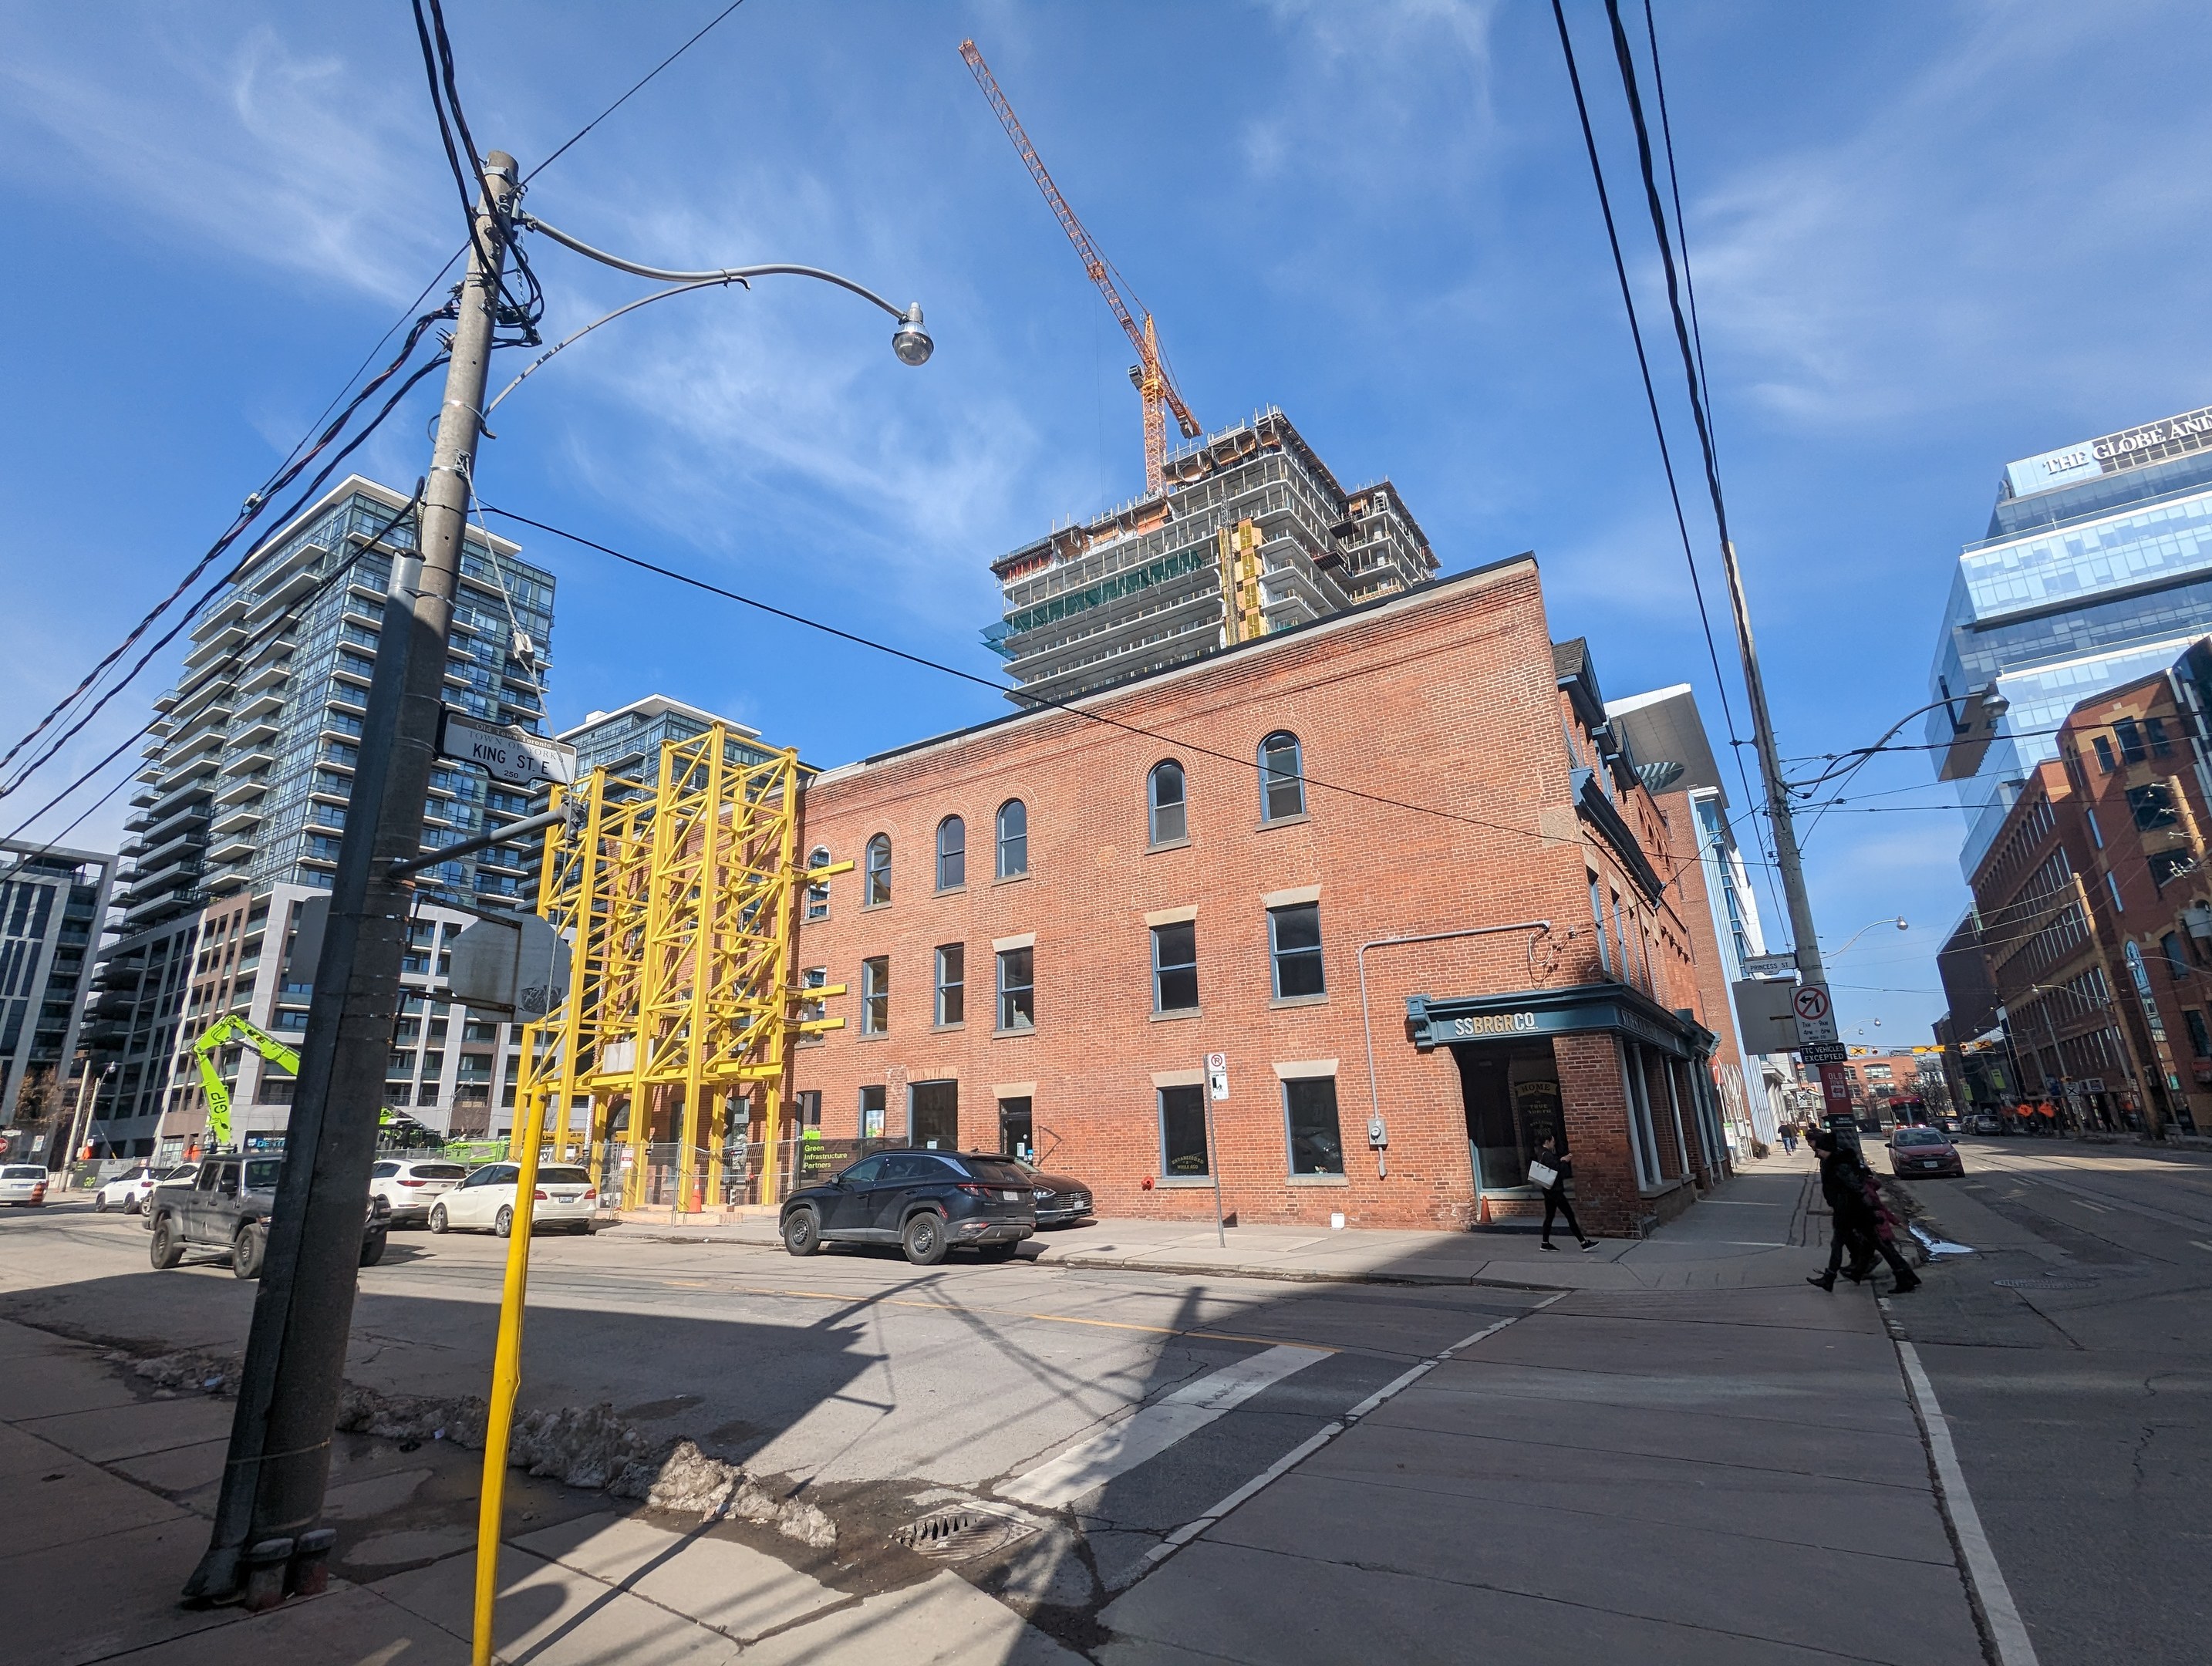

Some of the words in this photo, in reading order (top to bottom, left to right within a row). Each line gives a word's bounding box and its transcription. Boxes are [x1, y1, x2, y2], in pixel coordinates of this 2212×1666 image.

[2043, 450, 2089, 475] THE
[2092, 428, 2166, 460] GLOBE
[476, 723, 491, 732] Old
[496, 728, 518, 740] Town
[521, 735, 552, 749] Toronto
[467, 730, 503, 746] TOWN
[508, 741, 523, 750] OF
[528, 747, 556, 760] YORK
[473, 743, 506, 764] KING
[517, 754, 535, 772] ST.
[541, 760, 550, 775] E
[504, 770, 519, 779] 250
[1750, 963, 1778, 971] PRINCESS
[1815, 1044, 1844, 1054] VEHICLES
[1805, 1054, 1844, 1062] EXCEPTED
[1522, 1084, 1550, 1093] HOME
[211, 1092, 228, 1114] GIP
